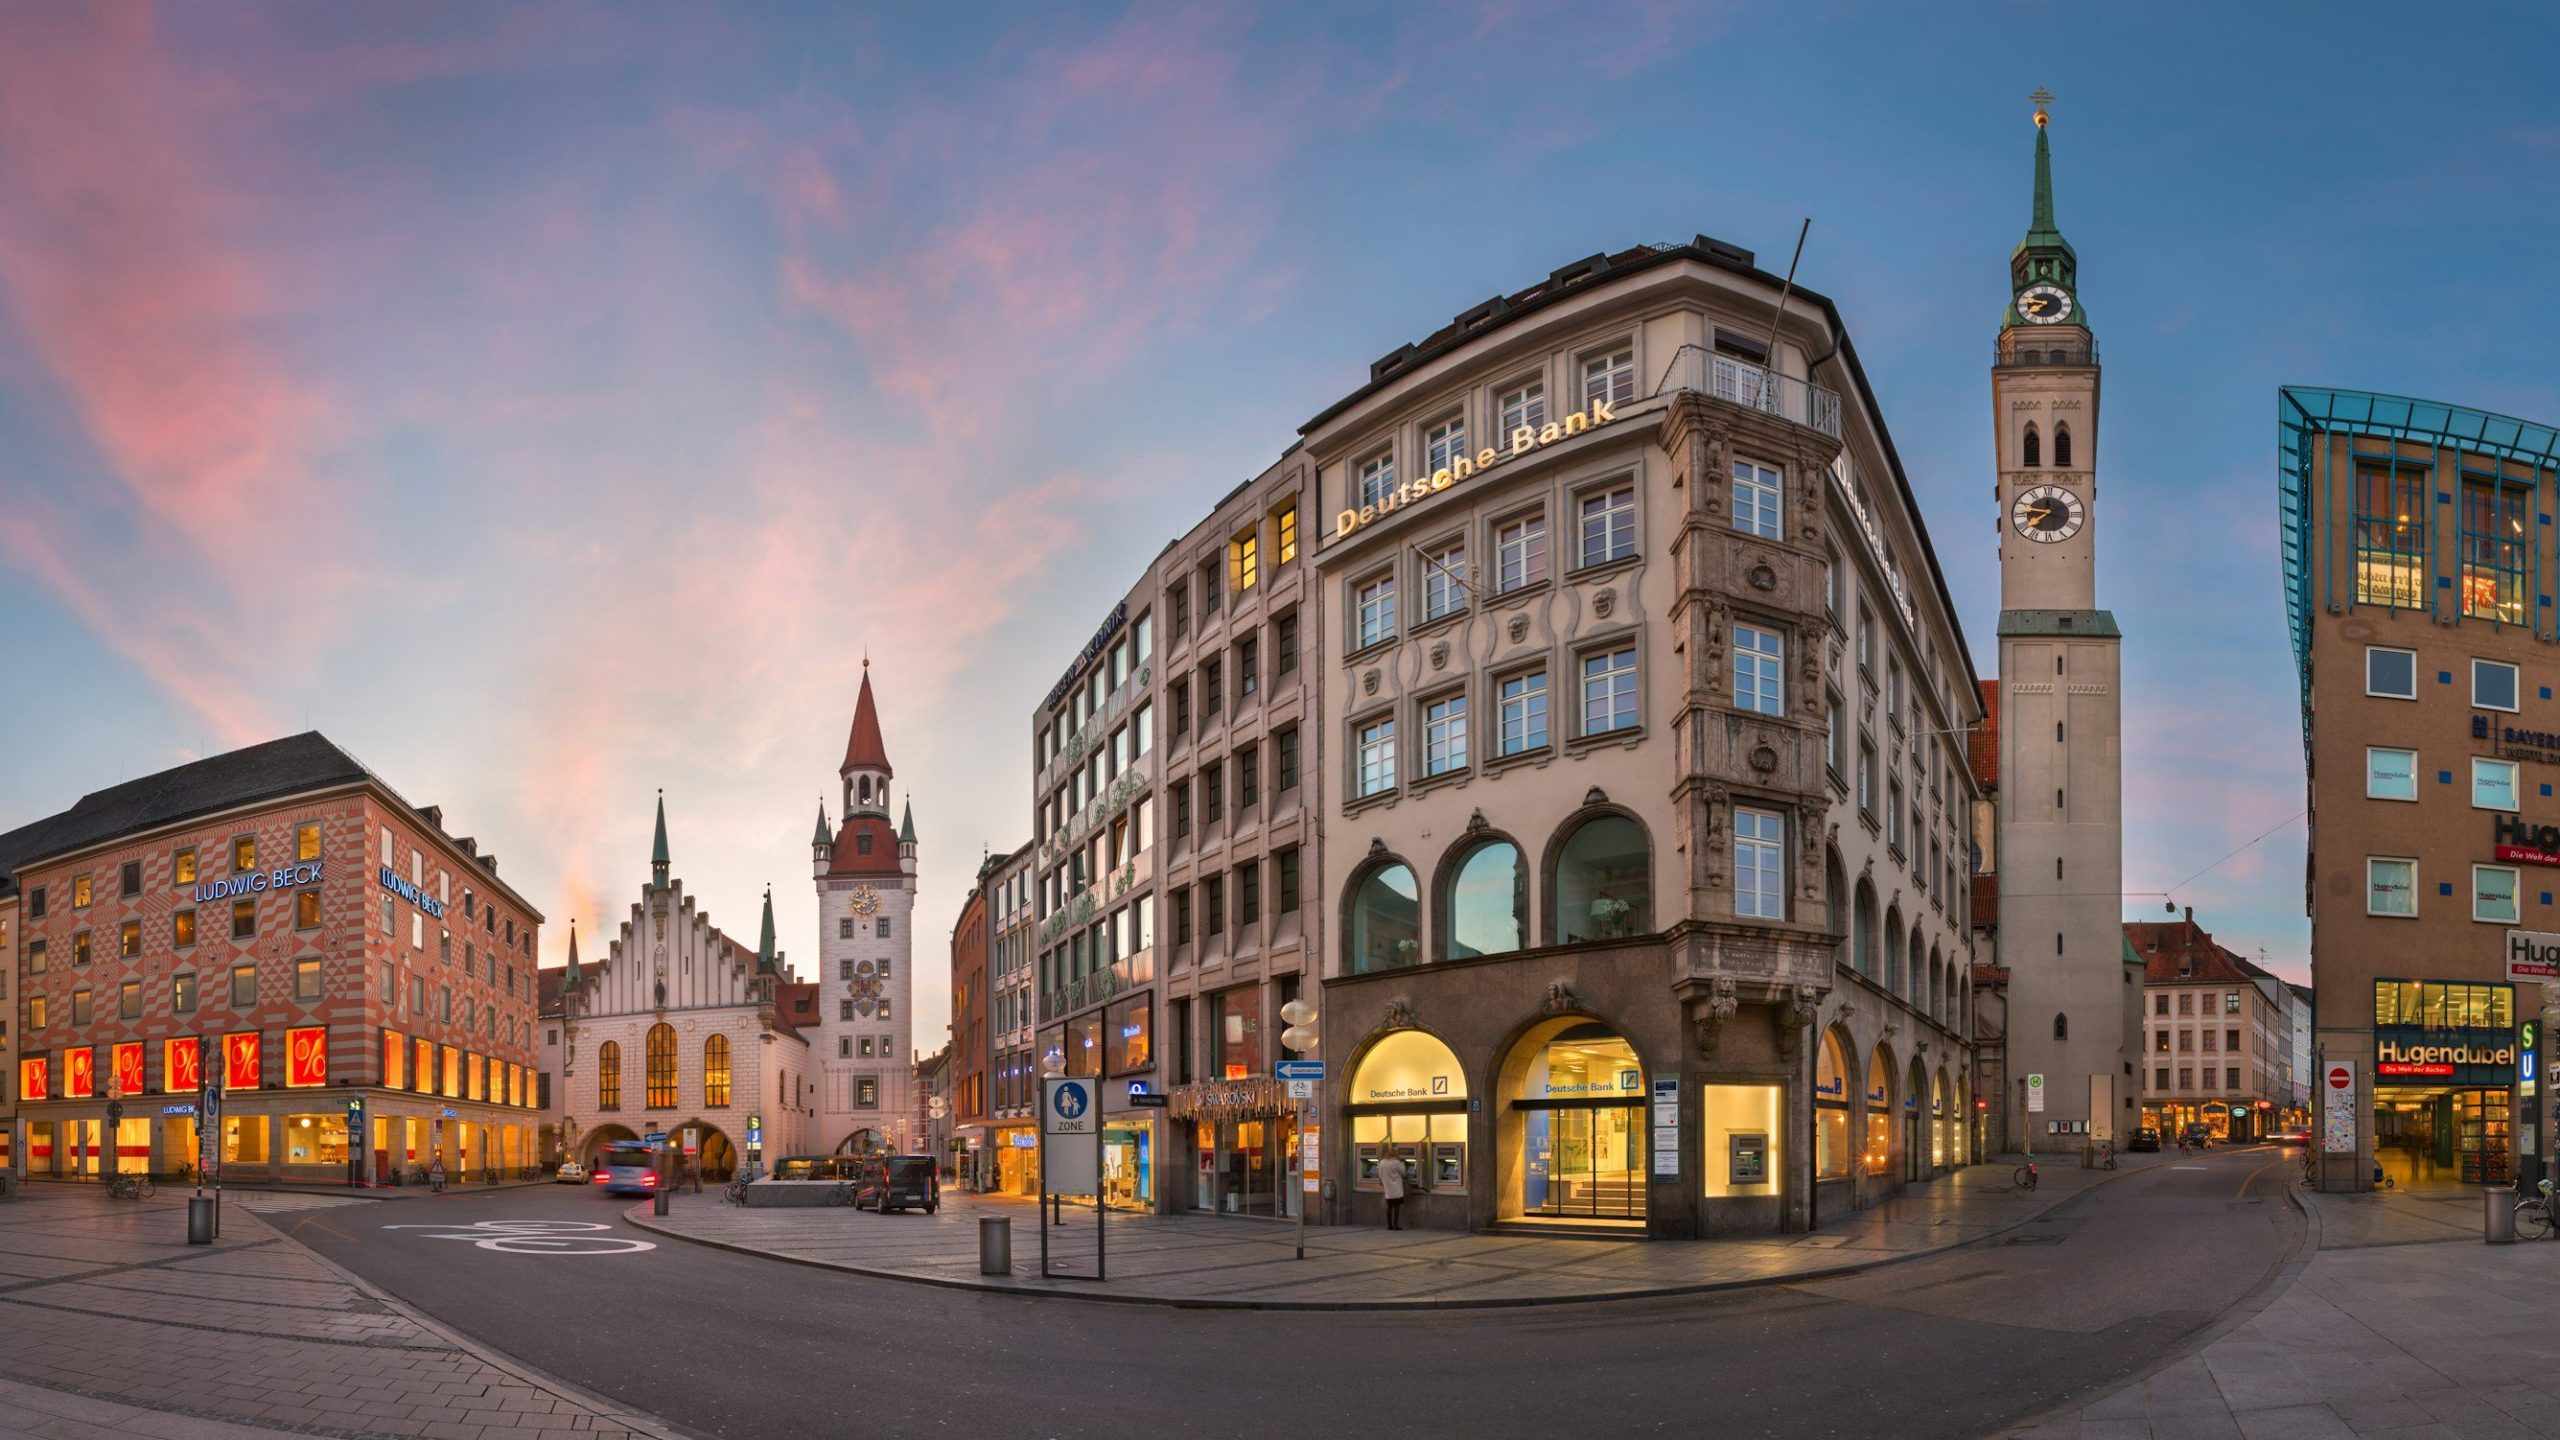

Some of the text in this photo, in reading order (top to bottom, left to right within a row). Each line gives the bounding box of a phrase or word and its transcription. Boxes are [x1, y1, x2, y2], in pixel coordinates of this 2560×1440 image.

[1337, 398, 1617, 538] Deutsche Bank
[1837, 455, 1914, 632] Deutsche Bank
[2495, 814, 2560, 854] Hug
[2510, 850, 2523, 858] Die
[2526, 852, 2543, 860] Welt
[195, 863, 324, 903] LUDWIG BECK
[381, 867, 443, 920] LUDWIG BECK
[2523, 1024, 2533, 1048] S
[2379, 1040, 2515, 1066] Hugendubel
[2523, 1054, 2532, 1077] U
[1207, 1090, 1255, 1105] SWAROVSKI
[1370, 1088, 1427, 1098] Deutsche Bank
[1545, 1083, 1614, 1093] Deutsche Bank
[751, 1117, 759, 1129] S
[1058, 1121, 1084, 1131] ZONE
